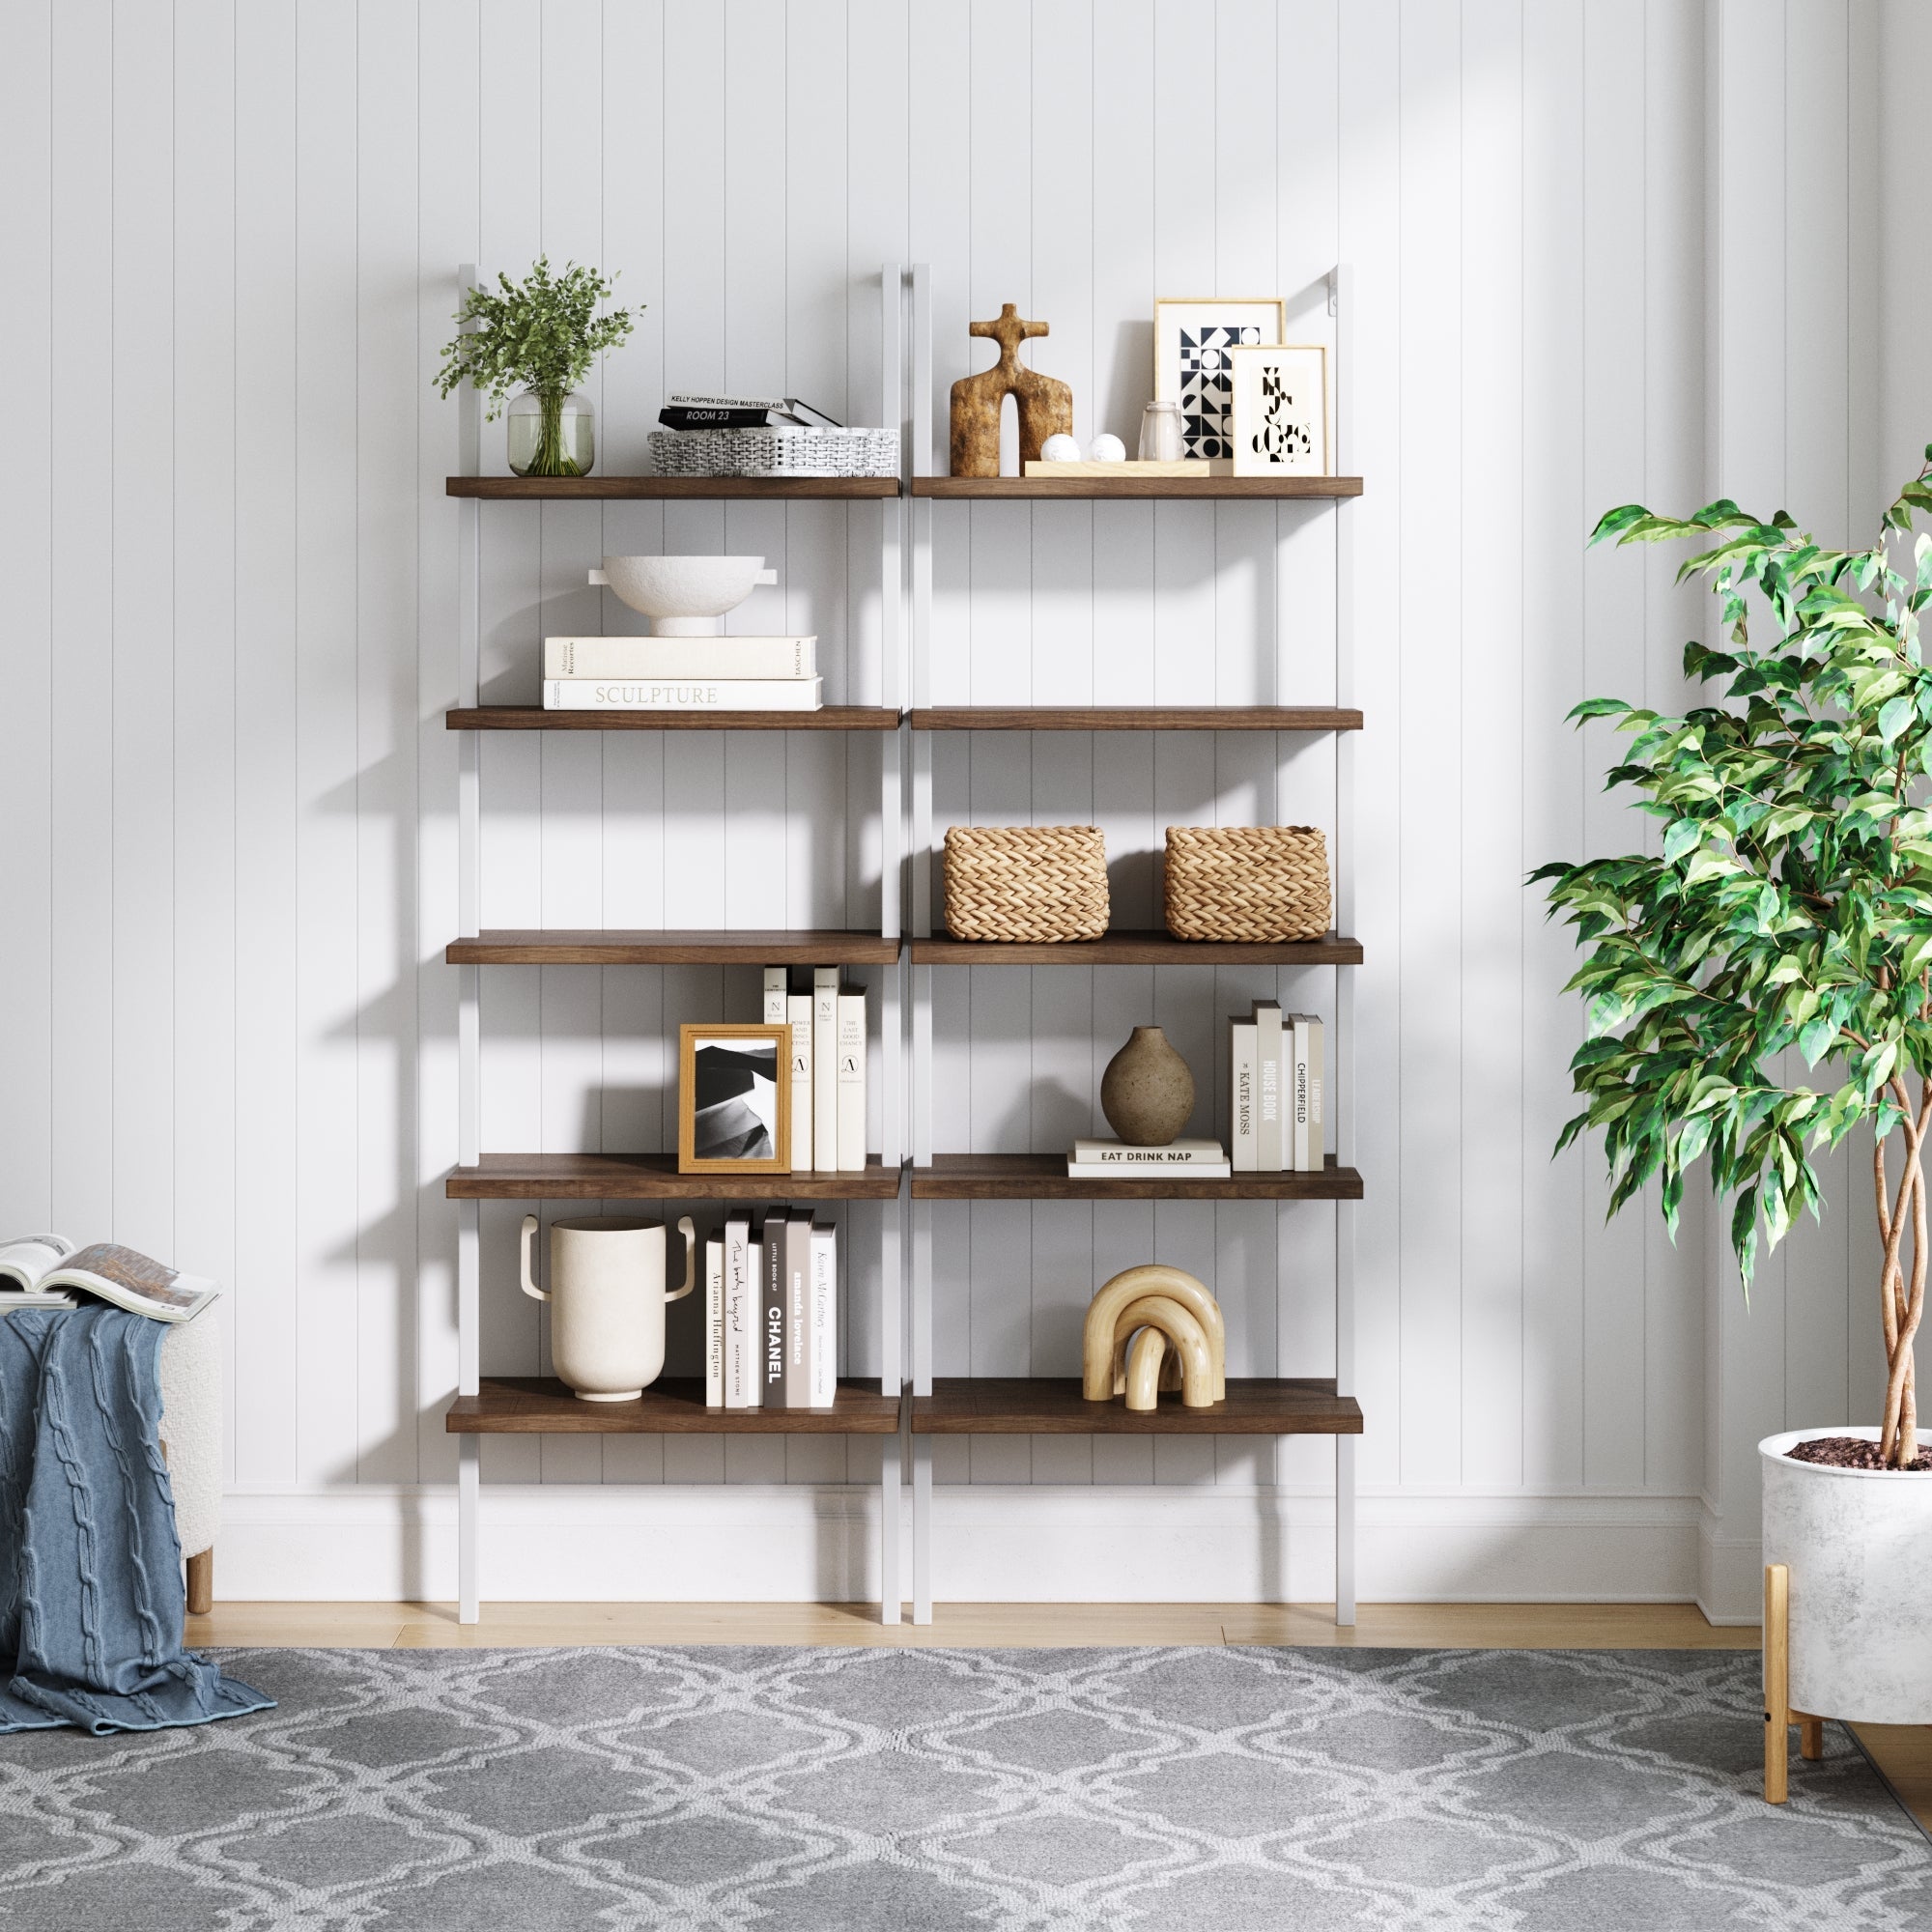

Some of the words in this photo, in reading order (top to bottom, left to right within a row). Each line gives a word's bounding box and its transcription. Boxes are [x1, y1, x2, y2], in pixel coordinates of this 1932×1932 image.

[686, 411, 717, 421] ROOM
[718, 411, 729, 420] 23
[739, 400, 783, 410] MASTERCLASS
[595, 687, 718, 703] SCULPTURE
[1239, 1072, 1250, 1101] KATE
[1264, 1061, 1276, 1094] HOUSE
[1297, 1063, 1306, 1123] CHIPPERFIELD
[1312, 1079, 1321, 1123] LEADERSHIP
[1239, 1104, 1250, 1135] MOSS
[1264, 1097, 1276, 1121] BOOK
[1101, 1152, 1122, 1161] EAT
[1127, 1152, 1163, 1161] DRINK
[1168, 1152, 1192, 1161] NAP
[732, 1240, 742, 1264] The
[713, 1273, 722, 1315] Arianna
[732, 1267, 745, 1291] body
[772, 1283, 777, 1292] OF
[794, 1271, 804, 1316] amanda
[727, 1295, 743, 1332] beyond
[711, 1320, 722, 1378] Huffington
[768, 1307, 781, 1383] CHANEL
